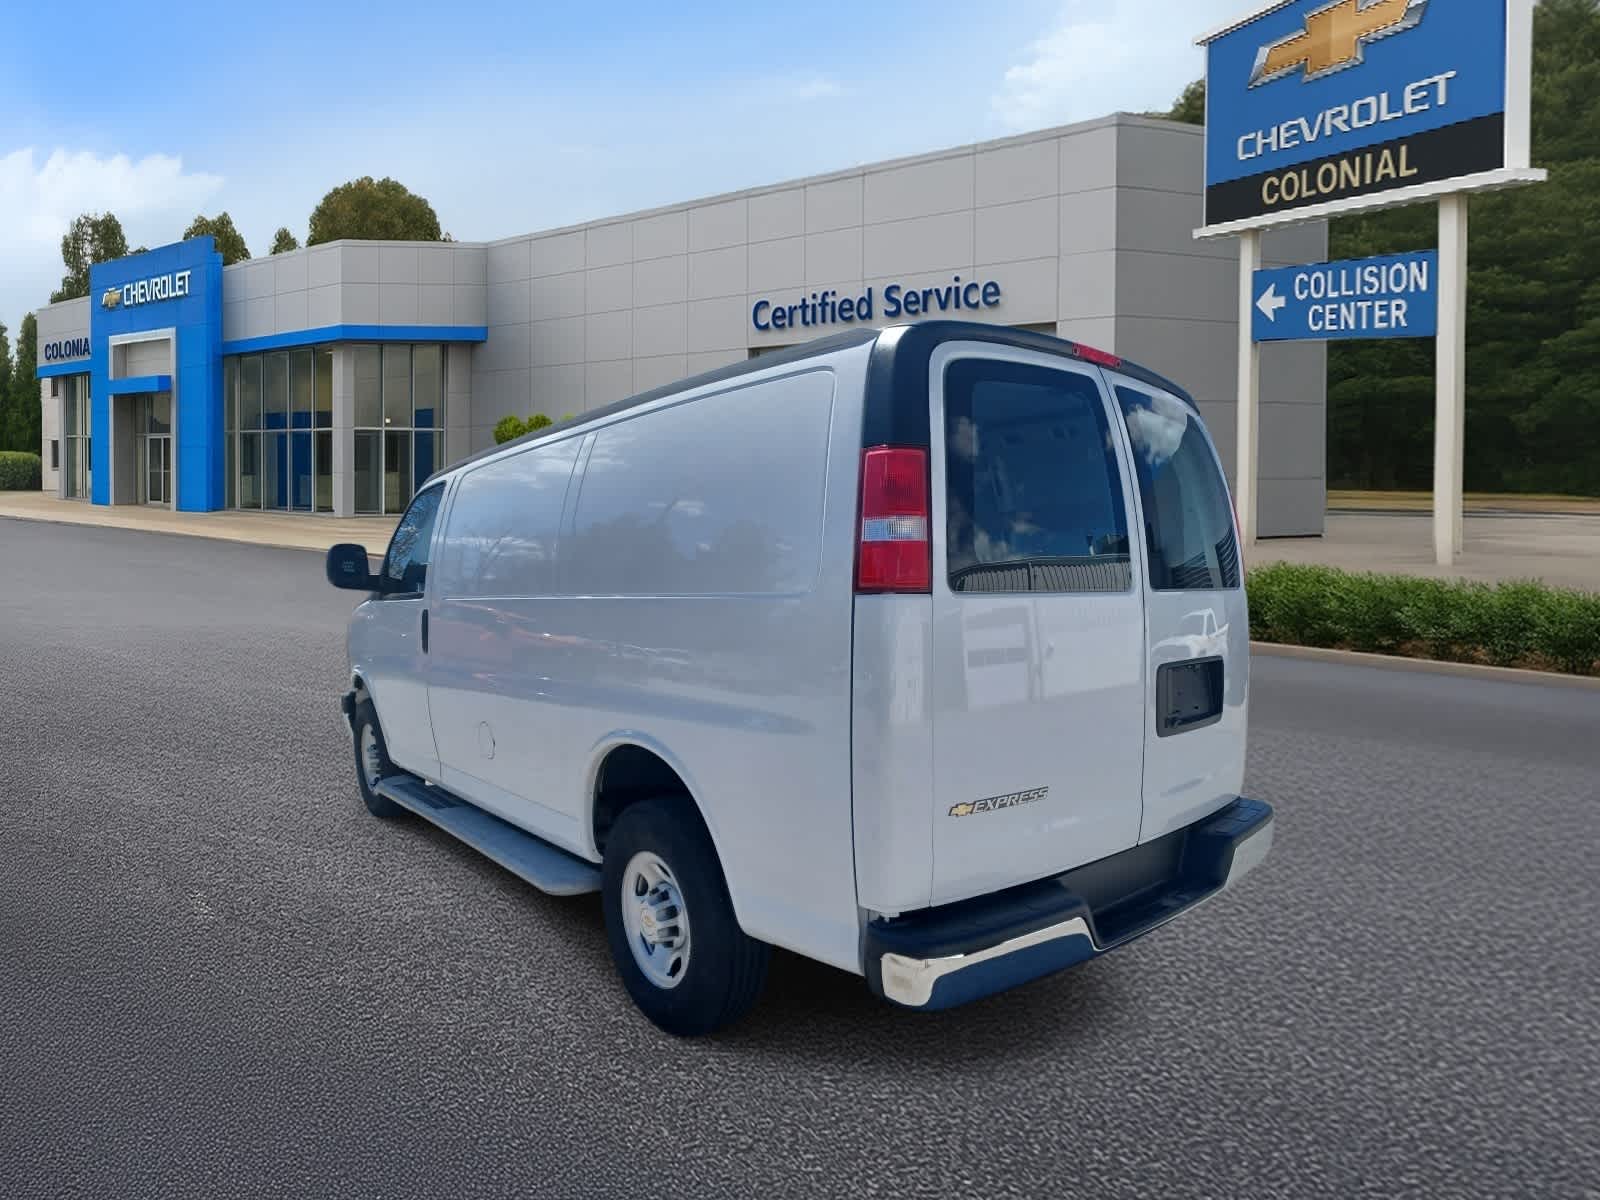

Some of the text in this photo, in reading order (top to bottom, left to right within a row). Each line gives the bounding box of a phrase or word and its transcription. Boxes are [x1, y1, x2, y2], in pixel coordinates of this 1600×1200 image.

[1237, 70, 1457, 161] CHEVROLET
[1261, 144, 1418, 206] COLONIAL
[123, 270, 191, 306] CHEVROLET
[1294, 260, 1428, 300] COLLISION
[752, 276, 1001, 330] Certified Service
[1308, 299, 1408, 331] CENTER
[971, 786, 1049, 814] EXPRESS
